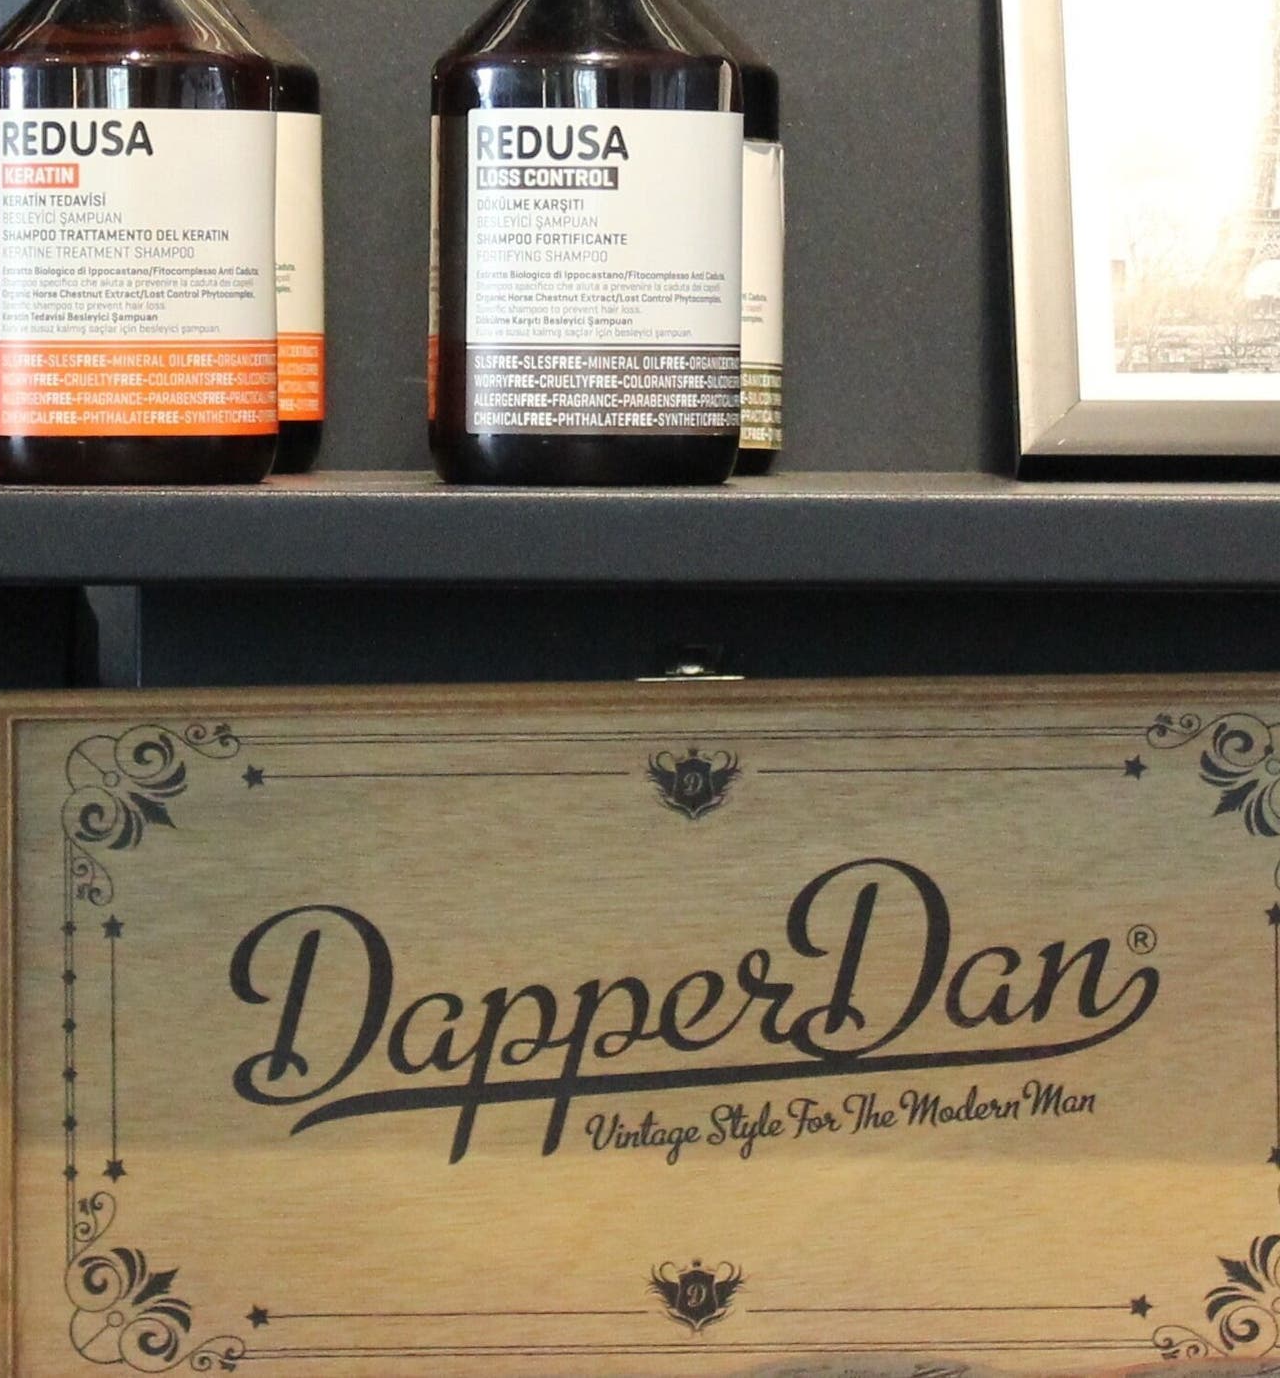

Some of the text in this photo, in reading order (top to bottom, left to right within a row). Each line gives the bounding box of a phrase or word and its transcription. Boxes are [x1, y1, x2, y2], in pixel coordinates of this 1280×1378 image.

[2, 120, 154, 157] REDUSA
[477, 124, 629, 161] REDUSA
[3, 167, 75, 184] KERATIN
[478, 169, 615, 187] LOSS CONTROL
[2, 229, 229, 241] SHAMPOO TRATTAMENTO DEL KERATIN
[477, 233, 628, 245] SHAMPOO FORTIFICANTE
[56, 246, 130, 259] TREATMENT
[134, 246, 195, 259] SHAMPOO
[545, 250, 608, 263] SHAMPOO
[60, 290, 102, 300] Chestnut
[536, 294, 578, 304] Chestnut
[585, 1079, 1097, 1165] Vintage Style For The Modern Man
